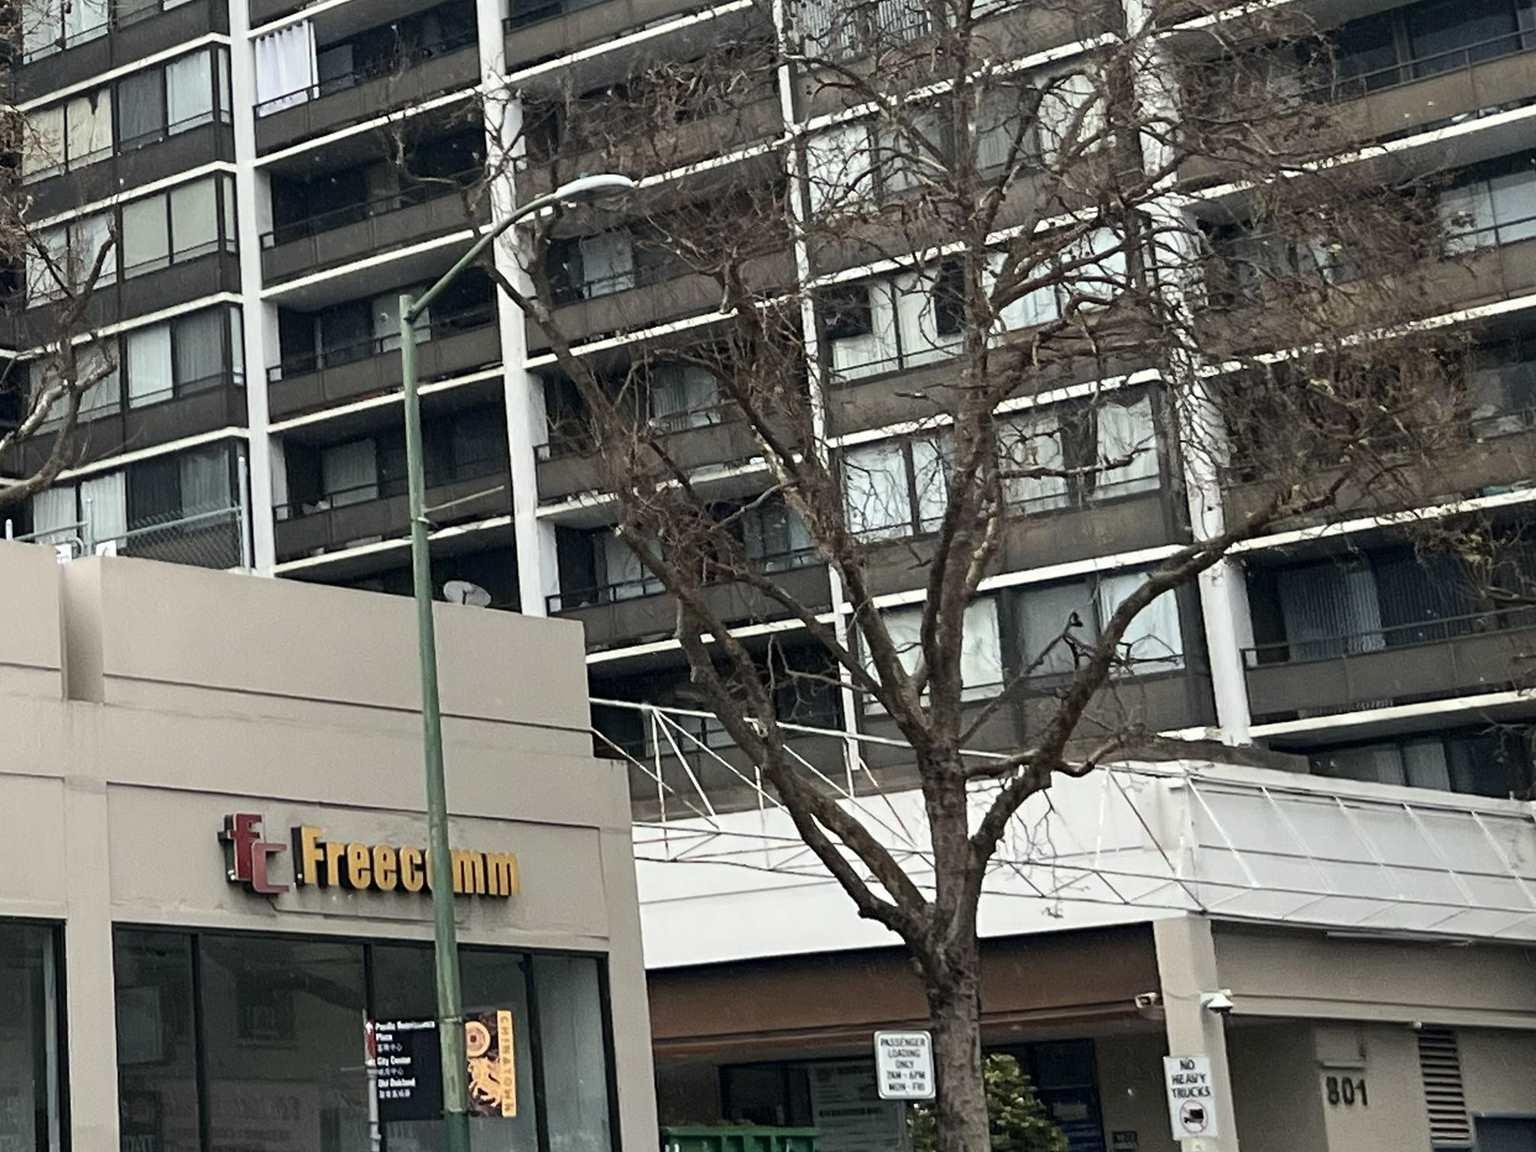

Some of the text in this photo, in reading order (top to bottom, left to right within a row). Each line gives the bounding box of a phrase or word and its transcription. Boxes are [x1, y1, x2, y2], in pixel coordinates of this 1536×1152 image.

[880, 1038, 926, 1047] PASSENGER
[887, 1048, 921, 1058] LOADING
[499, 1014, 515, 1113] CHINATOWN
[895, 1060, 914, 1068] ONLY
[1179, 1059, 1195, 1070] NO
[1171, 1073, 1206, 1085] HEAVY
[888, 1083, 906, 1092] MON
[912, 1082, 925, 1091] FRI
[1171, 1086, 1211, 1098] TRUCKS
[1326, 1076, 1368, 1106] 801
